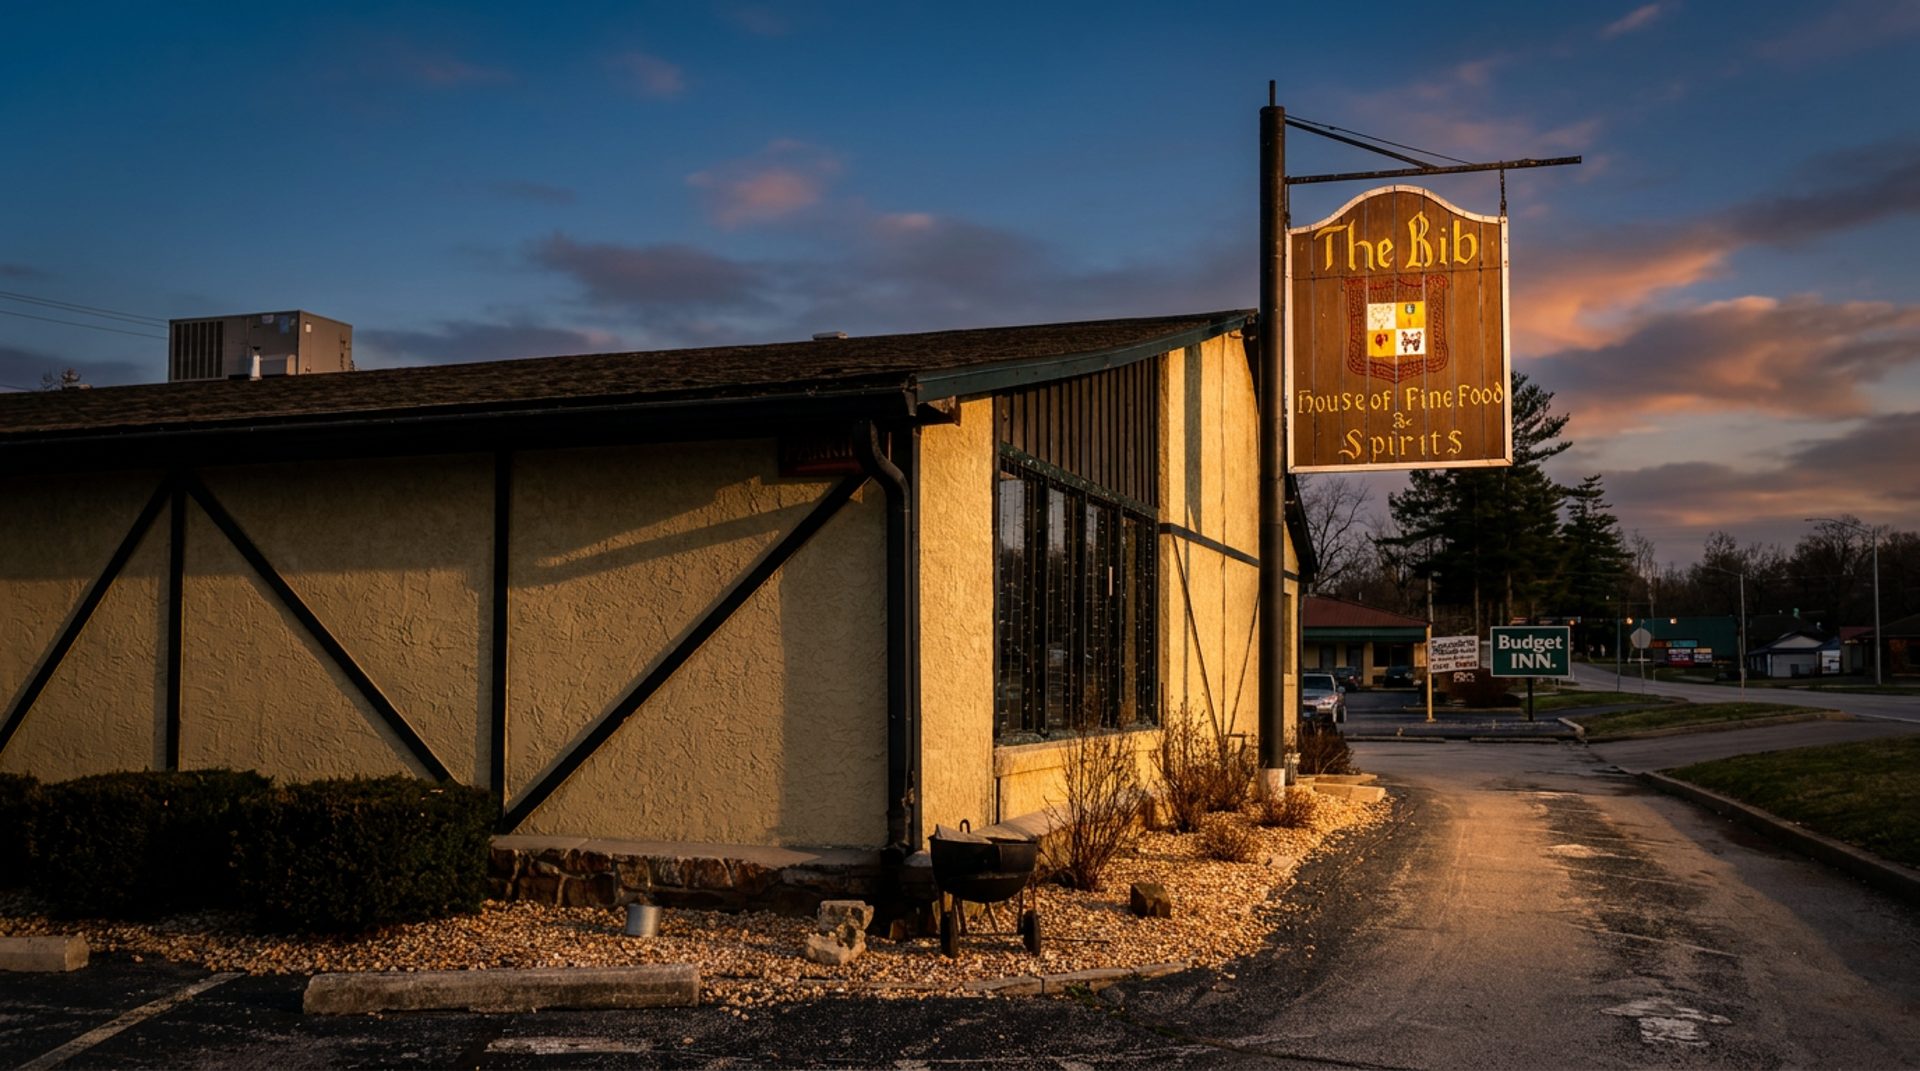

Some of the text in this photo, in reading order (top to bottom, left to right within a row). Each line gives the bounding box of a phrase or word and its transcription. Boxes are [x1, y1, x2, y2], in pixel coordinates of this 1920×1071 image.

[1314, 211, 1477, 271] The Bib
[1371, 389, 1392, 411] of
[1406, 386, 1453, 411] Fine
[1458, 382, 1504, 409] Food
[1393, 411, 1413, 429] &
[1338, 428, 1463, 463] Spirits
[1498, 634, 1563, 653] Budget
